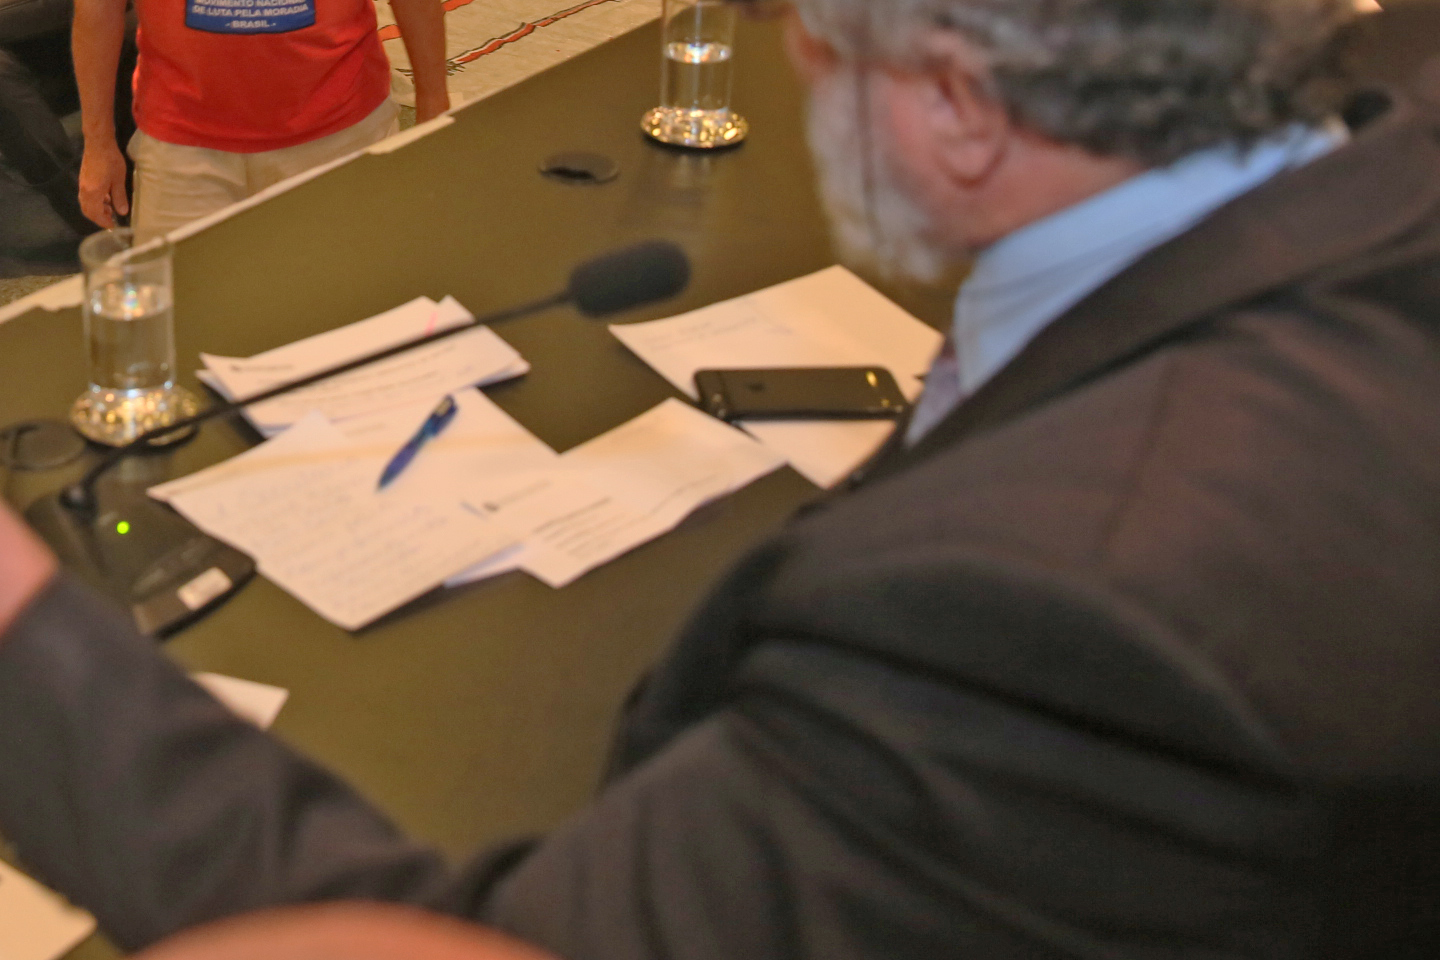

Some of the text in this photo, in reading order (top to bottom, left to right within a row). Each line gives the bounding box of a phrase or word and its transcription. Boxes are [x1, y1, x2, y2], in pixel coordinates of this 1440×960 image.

[192, 3, 309, 17] DE LUTA PELA MORADIA
[231, 20, 269, 28] BRASIL
